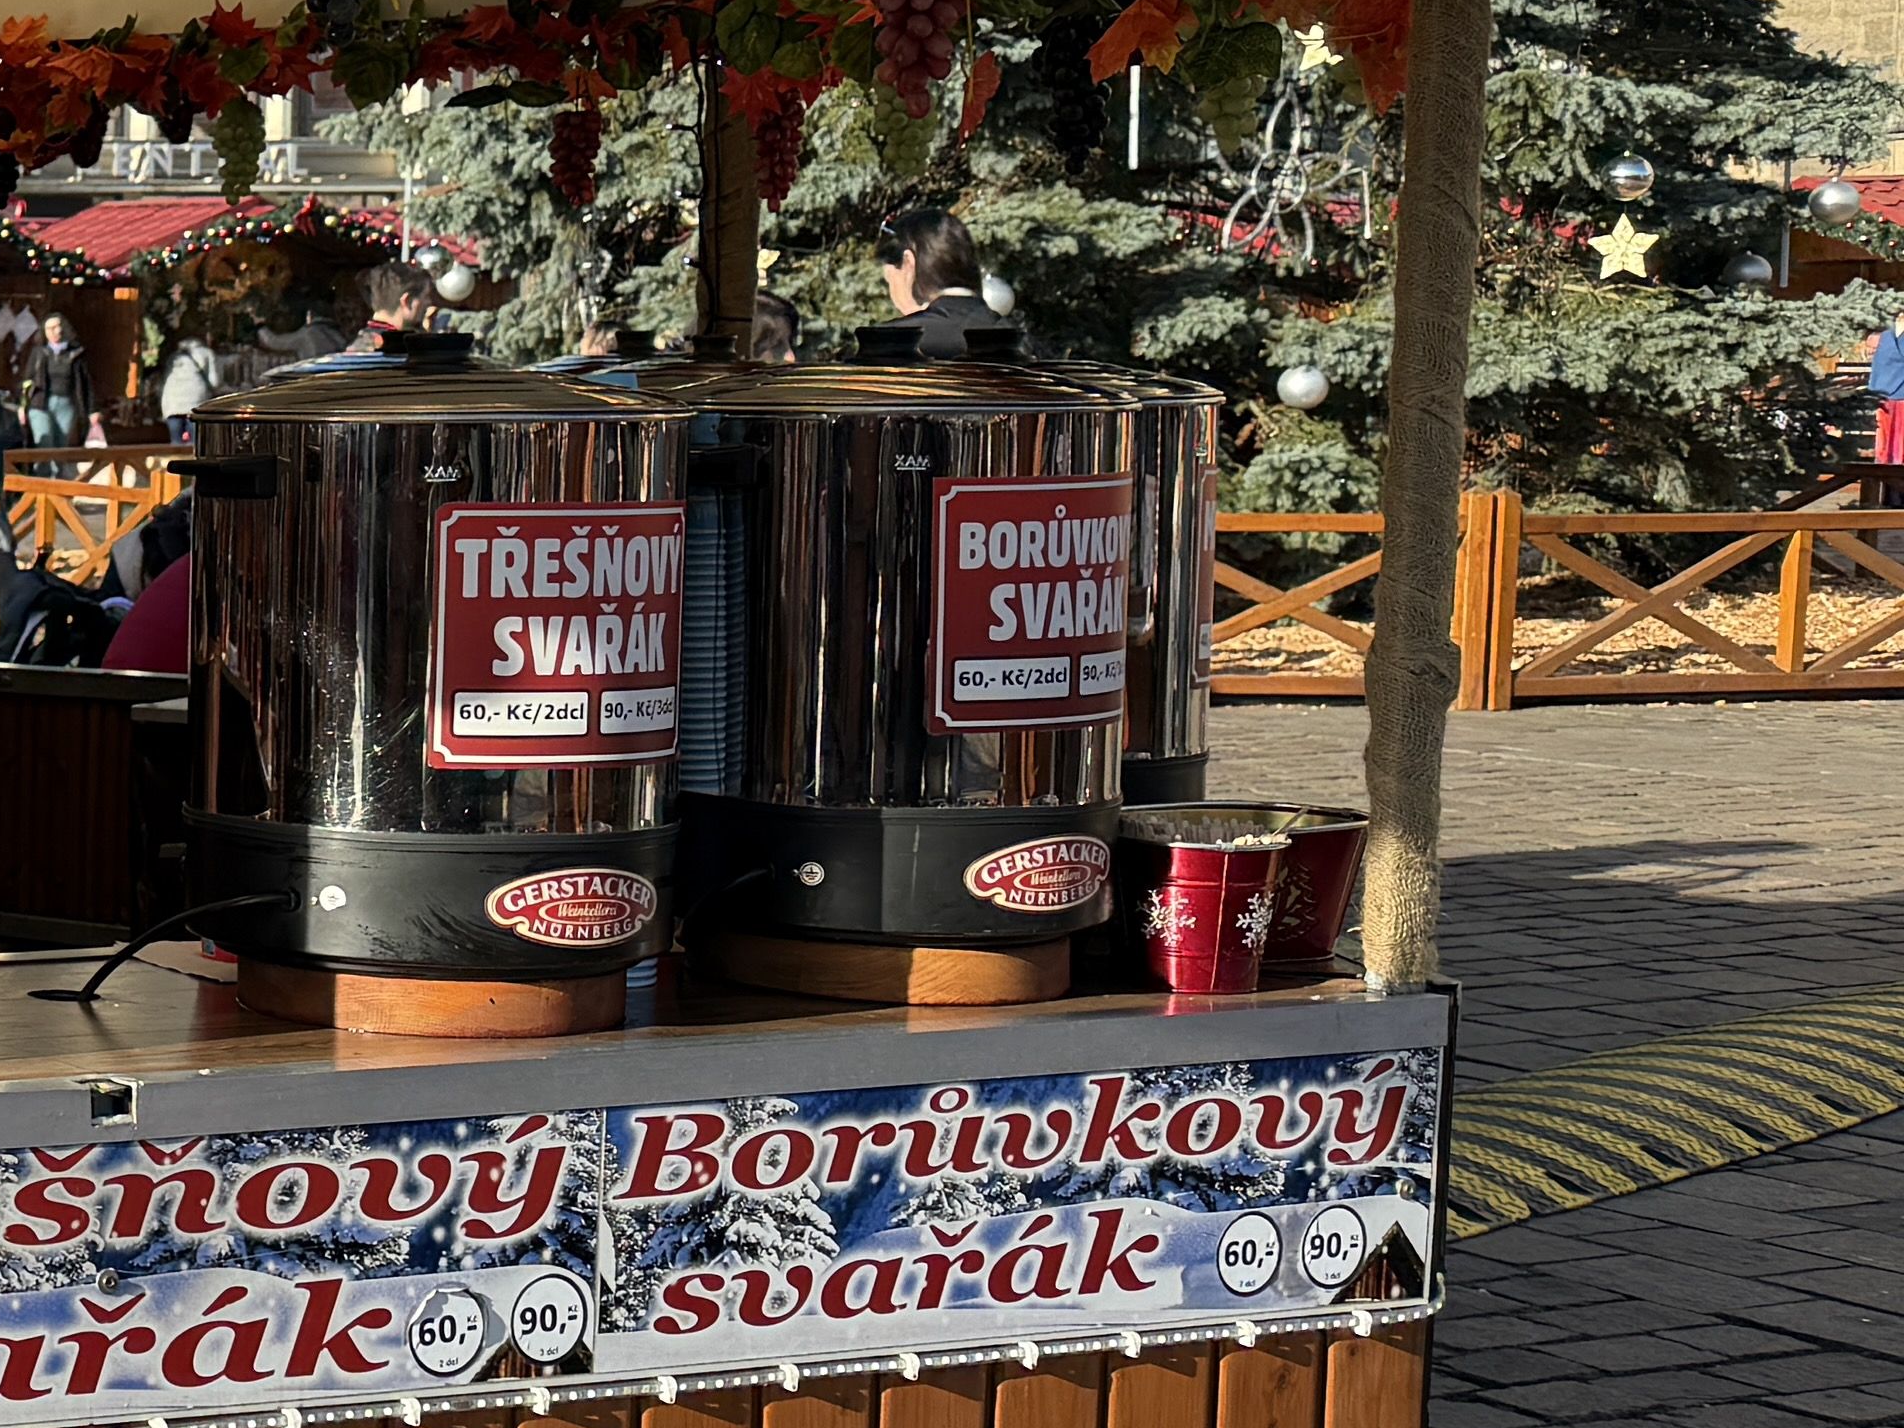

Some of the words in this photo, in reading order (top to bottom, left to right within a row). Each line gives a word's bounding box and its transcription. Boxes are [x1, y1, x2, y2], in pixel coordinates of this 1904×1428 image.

[455, 523, 681, 598] TŘEŠŇOVÝ
[492, 602, 667, 677] SVAŘÁK
[988, 566, 1125, 642] SVAŘÁK
[459, 704, 500, 722] 60,-
[507, 702, 585, 724] Kč/2dcl
[603, 703, 633, 721] 90,-
[958, 670, 996, 688] 60,-
[1002, 667, 1068, 689] Kč/2dcl
[503, 875, 651, 912] GERSTACKER
[981, 843, 1106, 884] GERSTACKER
[612, 1059, 1408, 1202] Borůvkový
[653, 1208, 1160, 1336] svařák
